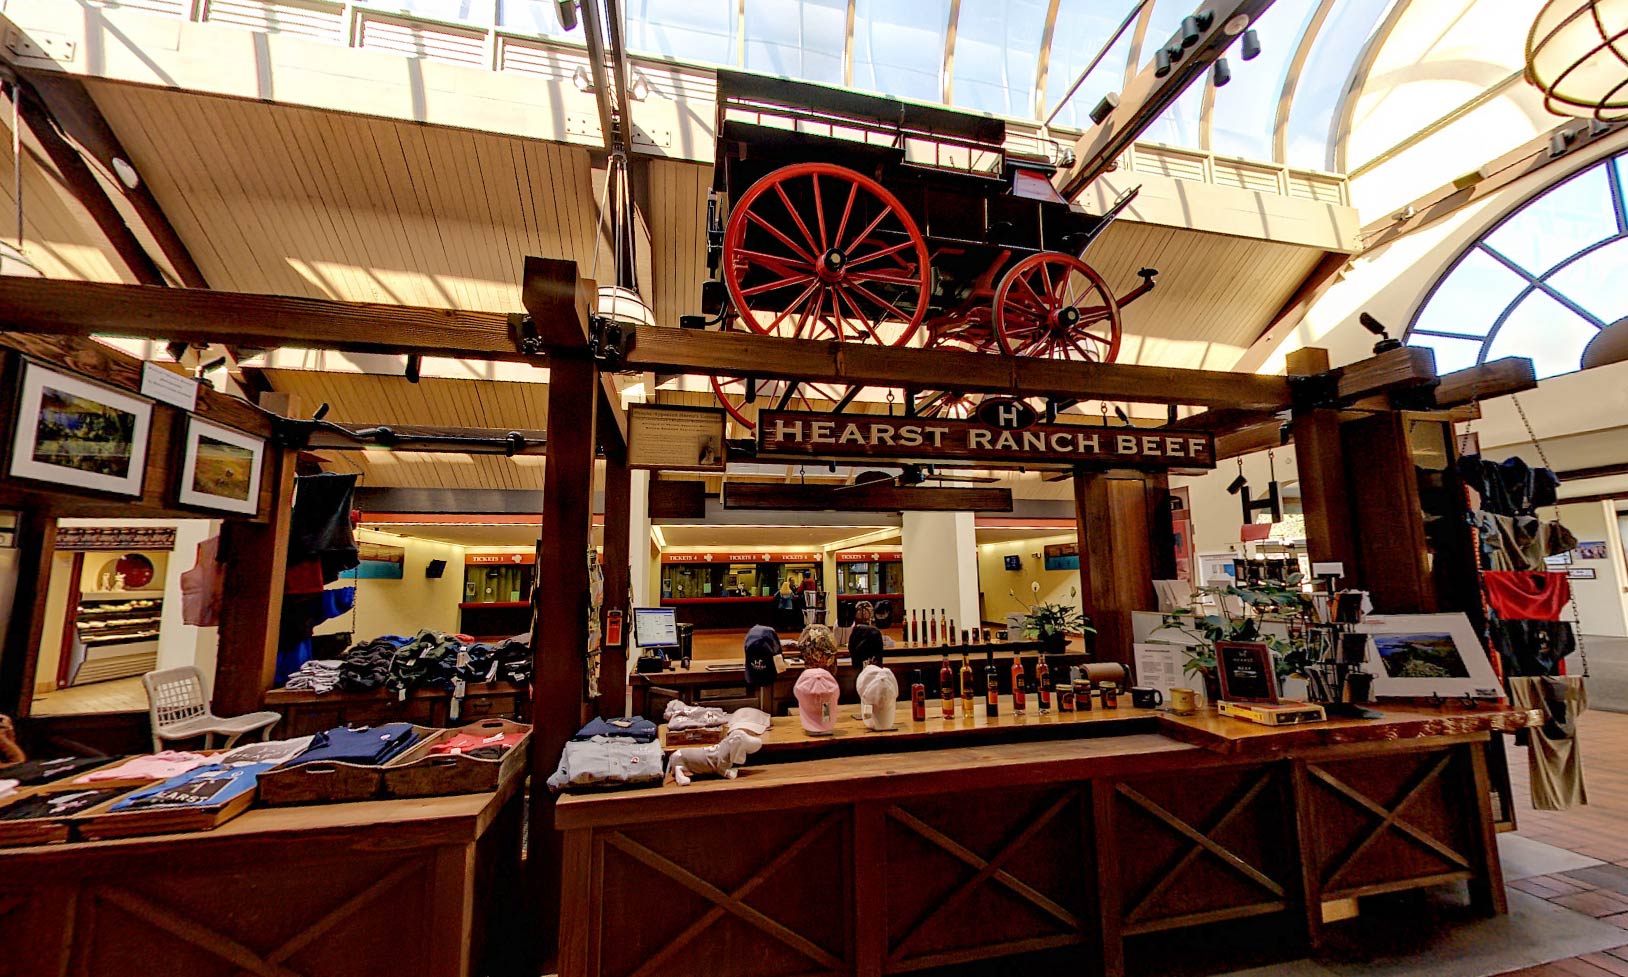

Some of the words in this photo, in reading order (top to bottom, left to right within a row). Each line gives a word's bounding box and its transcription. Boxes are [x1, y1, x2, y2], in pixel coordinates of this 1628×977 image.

[775, 419, 949, 448] HEARST
[968, 429, 1100, 453] RANCH
[1115, 435, 1206, 457] BEEF
